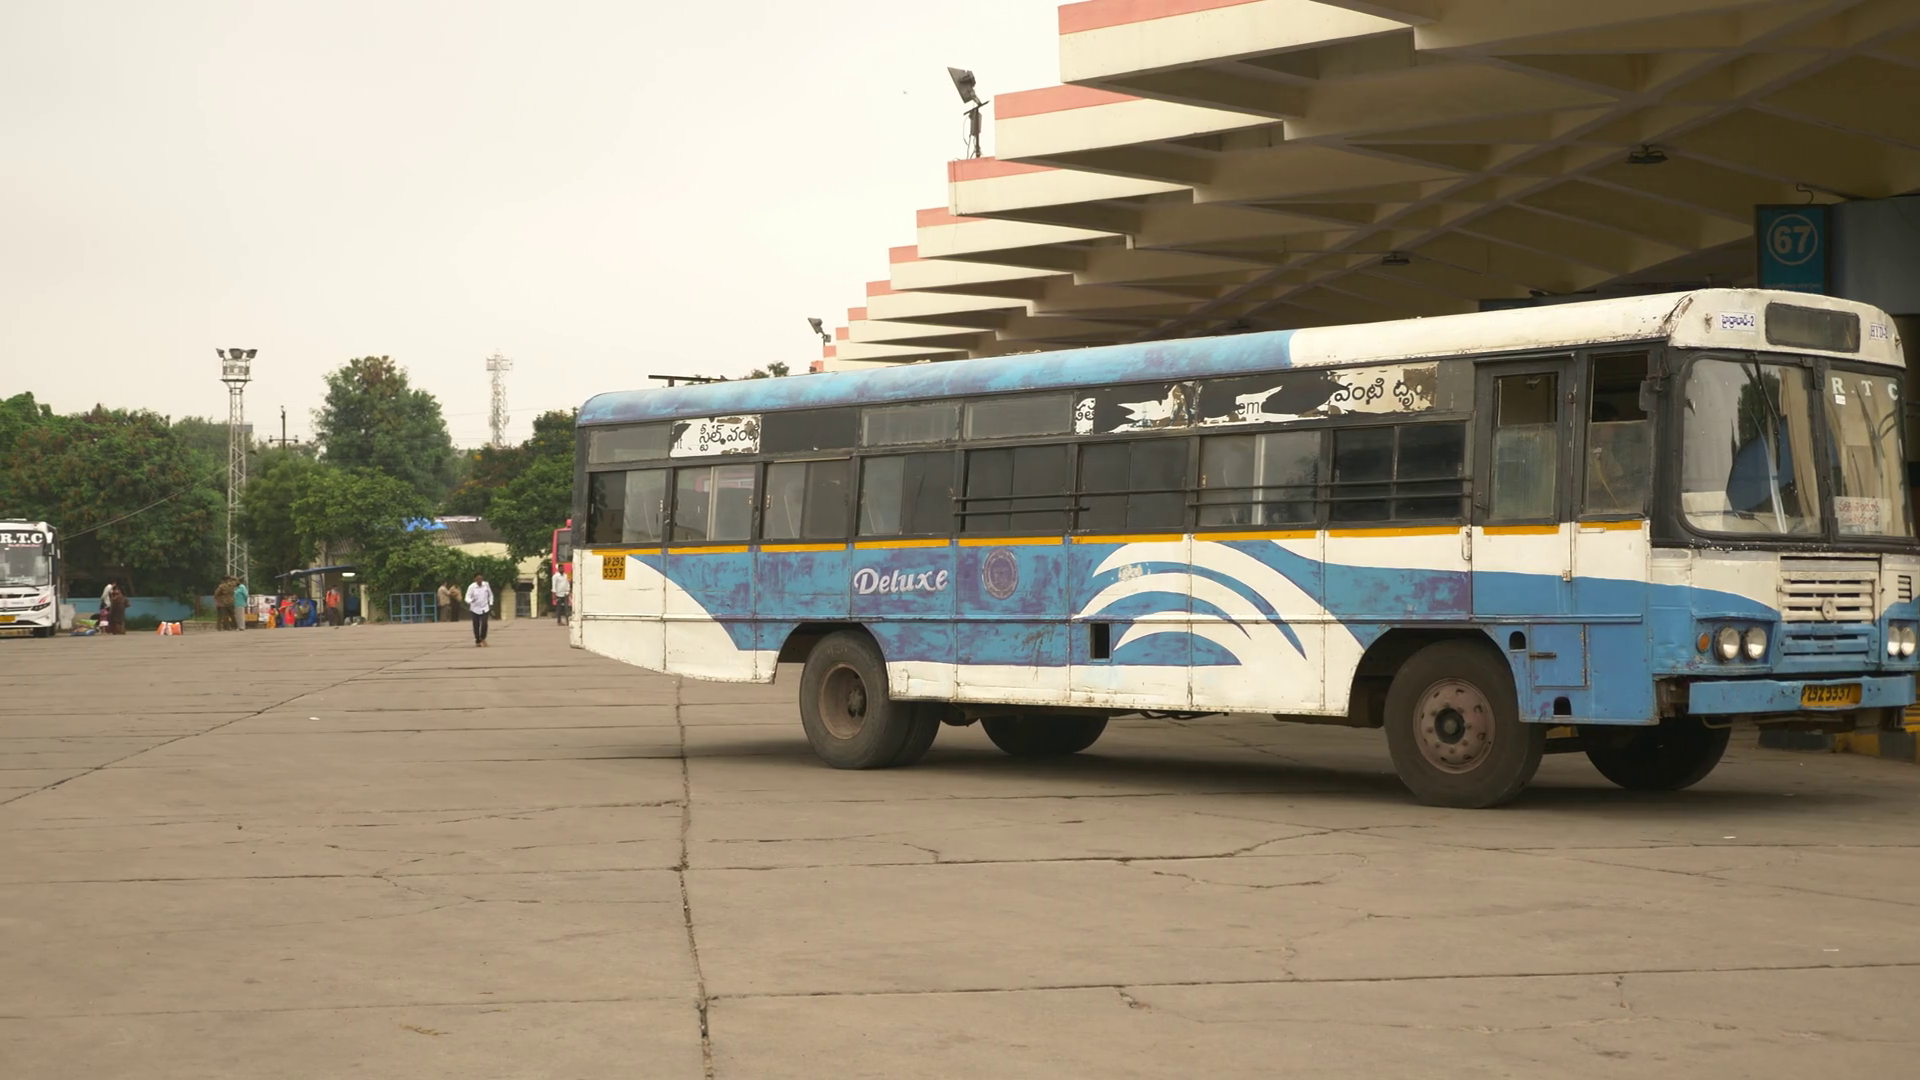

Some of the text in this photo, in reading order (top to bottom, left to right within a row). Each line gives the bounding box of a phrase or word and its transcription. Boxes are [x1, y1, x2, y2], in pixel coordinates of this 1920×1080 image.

[1774, 225, 1811, 254] 67
[604, 567, 623, 578] 3337
[854, 568, 949, 595] Deluxe
